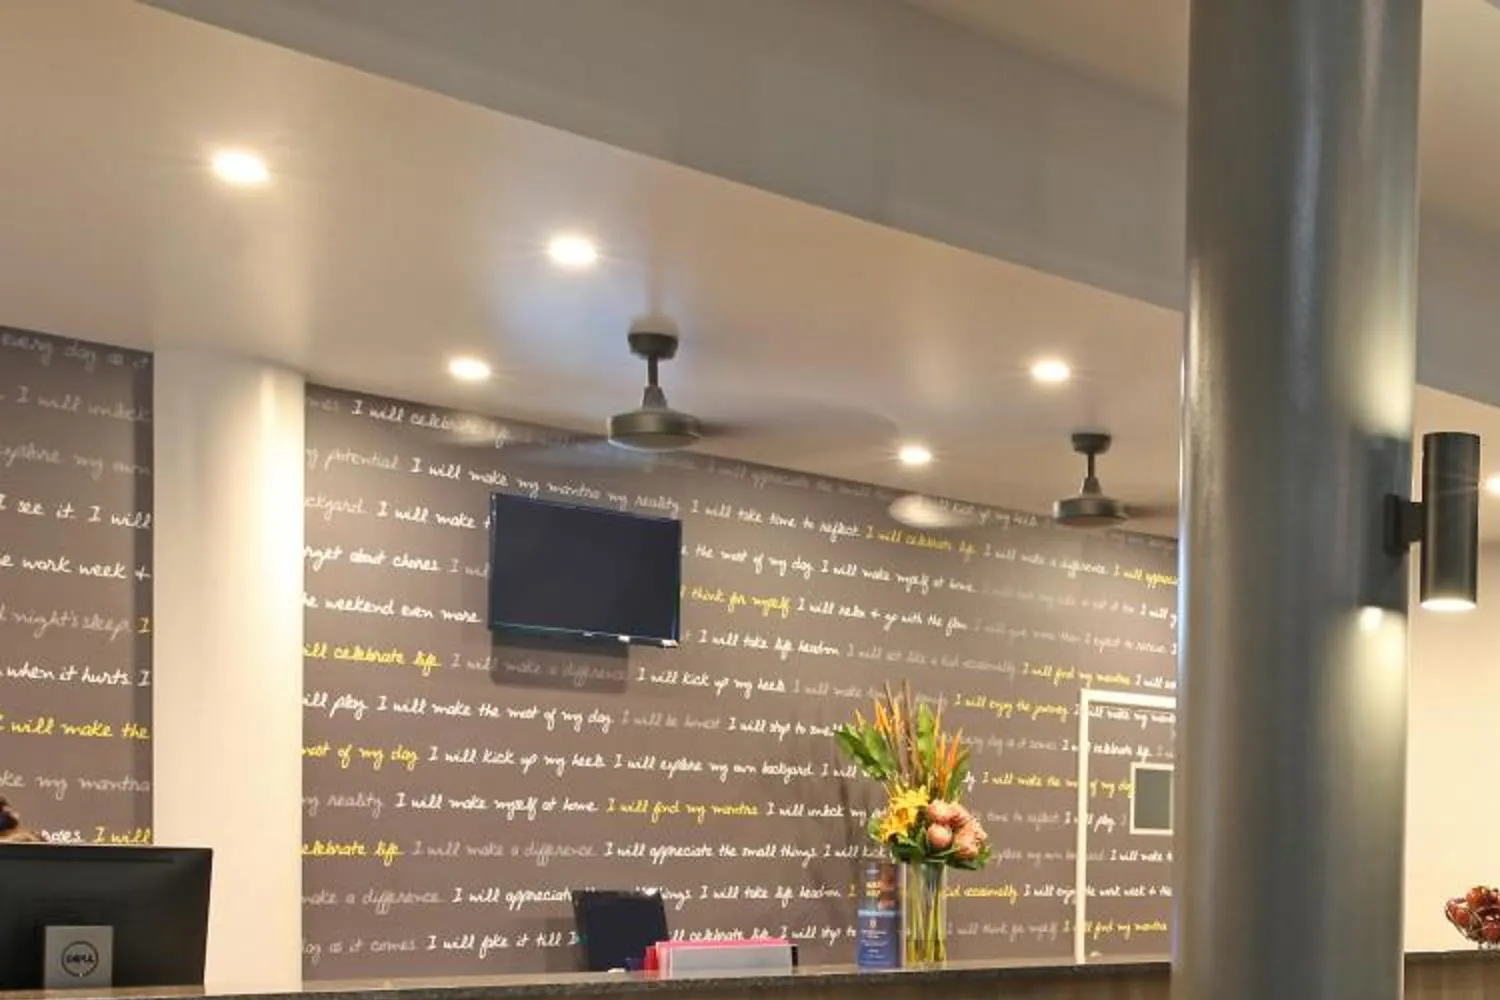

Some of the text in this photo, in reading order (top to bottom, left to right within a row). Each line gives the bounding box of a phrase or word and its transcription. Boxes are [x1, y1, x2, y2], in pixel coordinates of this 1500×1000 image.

[410, 457, 422, 473] I
[428, 464, 462, 480] will
[468, 470, 508, 488] make
[516, 479, 540, 499] my
[690, 499, 698, 513] I
[705, 504, 731, 518] will
[737, 508, 763, 523] take
[879, 529, 903, 543] will
[17, 500, 46, 516] see
[88, 505, 102, 522] I
[111, 512, 151, 529] will
[376, 501, 477, 528] I will make
[22, 556, 128, 579] work week
[695, 544, 714, 558] the
[720, 549, 748, 562] most
[753, 552, 765, 574] of
[768, 558, 787, 577] my
[820, 560, 830, 573] I
[834, 564, 858, 577] will
[326, 595, 395, 616] weekend
[797, 597, 806, 611] I
[810, 601, 835, 615] will
[698, 629, 707, 643] I
[712, 632, 739, 647] will
[7, 661, 55, 679] when
[59, 666, 78, 681] it
[82, 666, 132, 686] hurts
[636, 668, 646, 681] I
[651, 671, 679, 684] will
[377, 696, 387, 711] I
[393, 698, 426, 714] will
[432, 700, 473, 716] make
[478, 703, 502, 718] the
[727, 717, 737, 731] I
[740, 719, 767, 732] will
[11, 717, 151, 739] will make the
[428, 746, 439, 761] I
[445, 749, 476, 763] will
[544, 755, 566, 777] my
[614, 754, 624, 768] I
[627, 756, 656, 769] will
[395, 792, 406, 807] I
[411, 794, 443, 809] will
[449, 795, 489, 810] make
[604, 842, 613, 857] I
[617, 843, 646, 857] will
[452, 888, 463, 903] I
[469, 888, 500, 903] will
[427, 935, 438, 950] I
[444, 934, 475, 949] will
